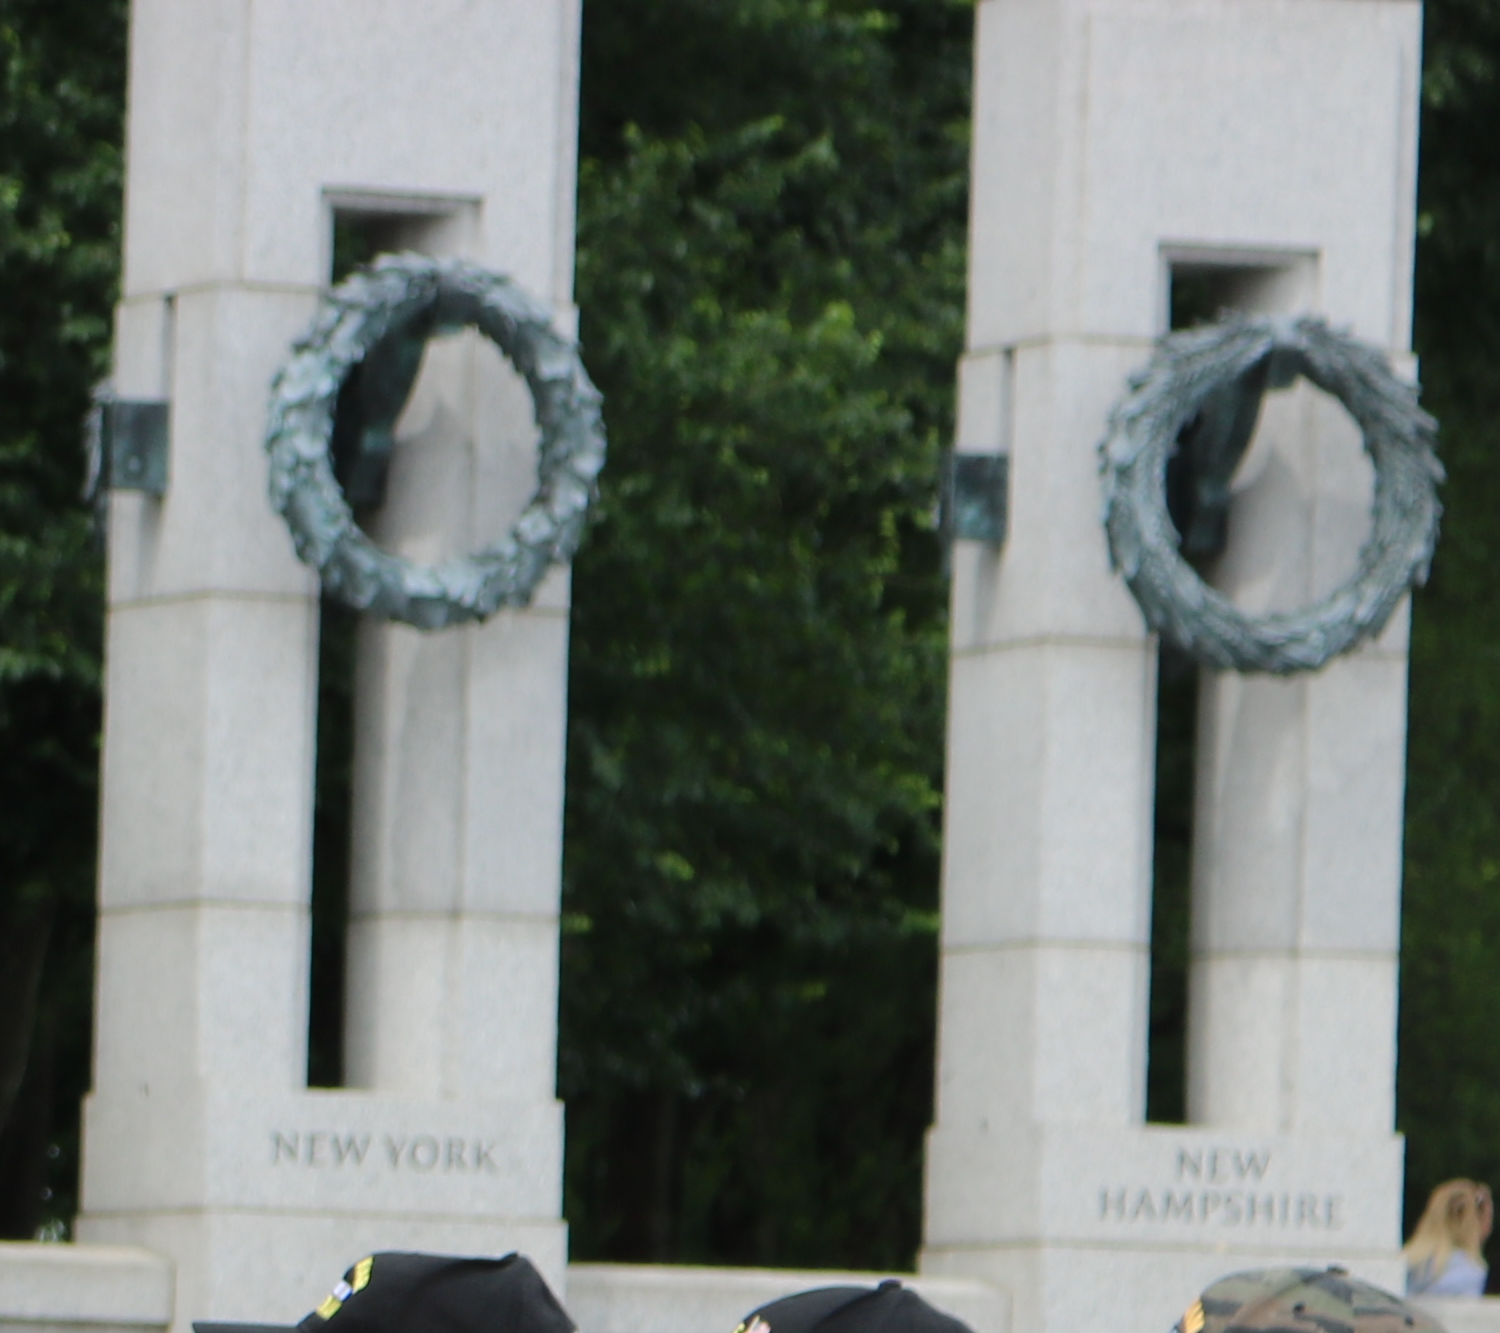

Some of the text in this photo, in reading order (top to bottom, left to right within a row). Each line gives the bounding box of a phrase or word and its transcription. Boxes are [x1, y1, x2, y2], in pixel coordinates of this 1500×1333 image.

[269, 1130, 499, 1175] NEW YORK
[1176, 1147, 1271, 1182] NEW
[1099, 1188, 1344, 1230] HAMPSHIRE
